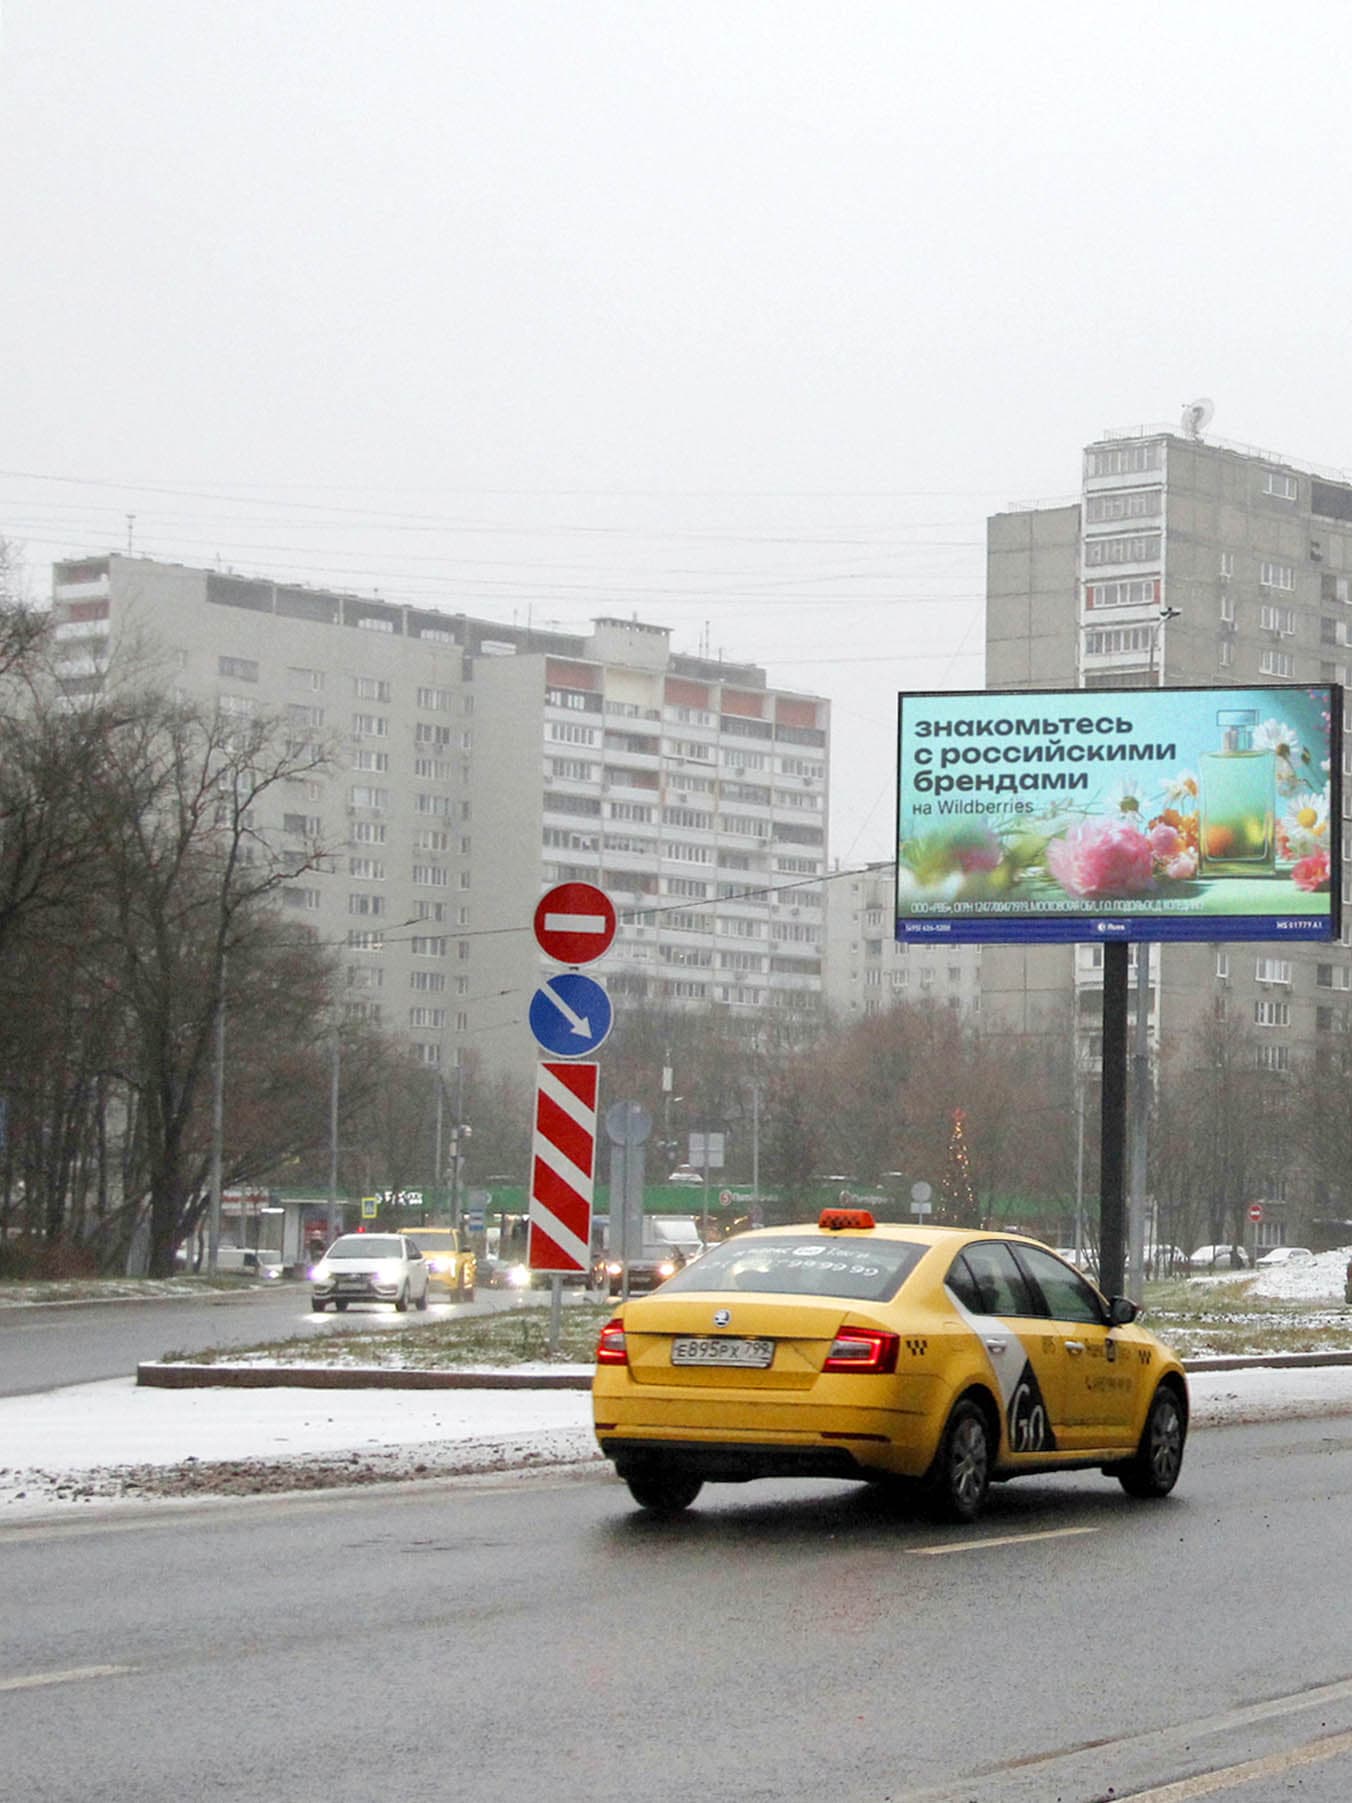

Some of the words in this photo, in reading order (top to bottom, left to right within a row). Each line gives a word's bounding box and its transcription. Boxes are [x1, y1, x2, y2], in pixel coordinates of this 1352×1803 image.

[914, 716, 1133, 738] знакомьтесь
[914, 747, 933, 765] с
[940, 738, 1176, 769] российскими
[913, 769, 1088, 796] брендами
[912, 803, 932, 815] на
[938, 799, 1034, 815] Wildberries
